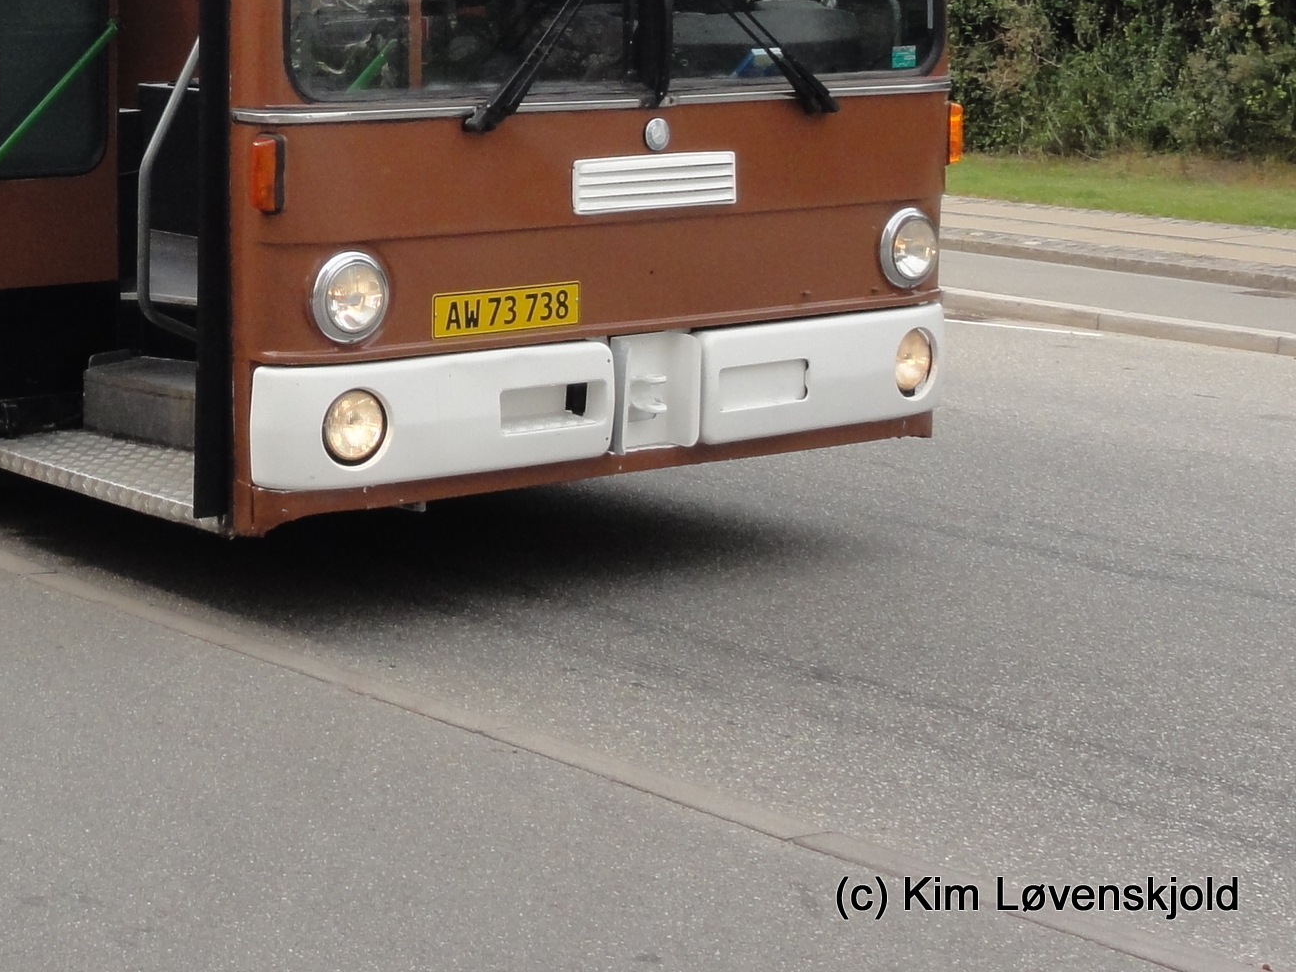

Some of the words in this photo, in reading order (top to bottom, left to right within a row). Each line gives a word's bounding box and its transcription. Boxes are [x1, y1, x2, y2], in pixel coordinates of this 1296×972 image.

[446, 299, 481, 330] AW
[488, 295, 517, 326] 73
[525, 290, 569, 322] 738
